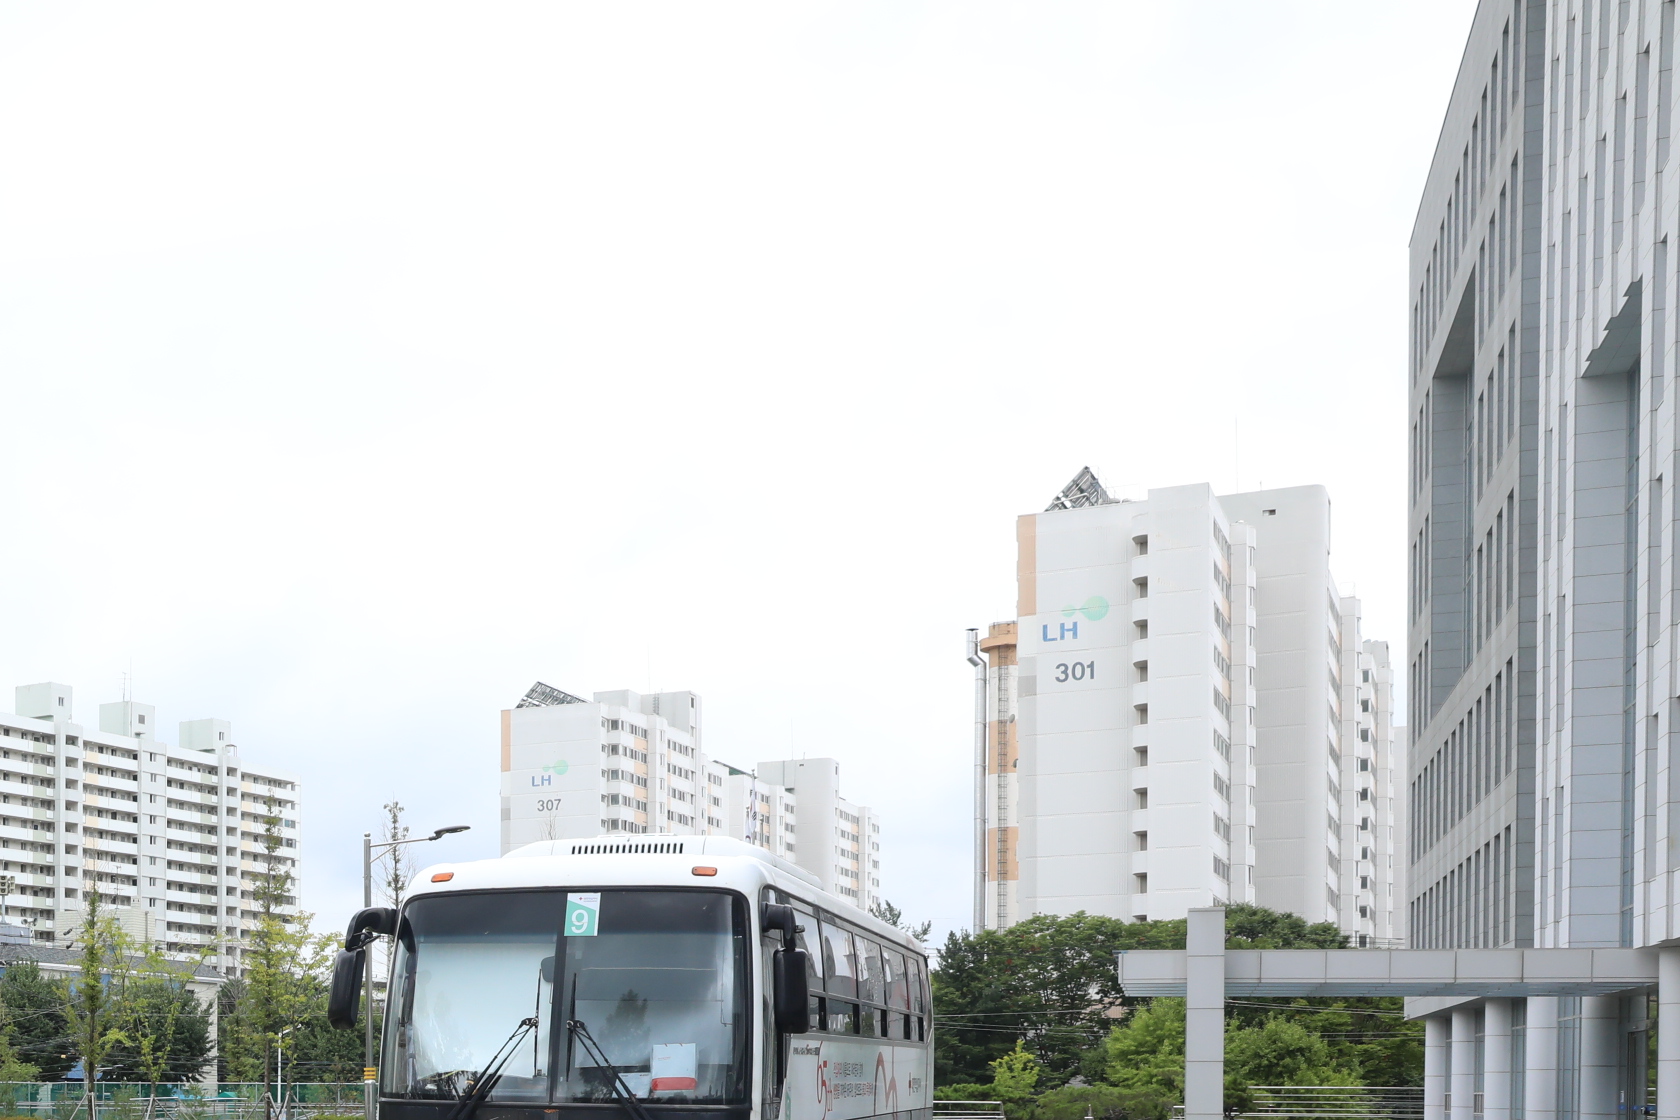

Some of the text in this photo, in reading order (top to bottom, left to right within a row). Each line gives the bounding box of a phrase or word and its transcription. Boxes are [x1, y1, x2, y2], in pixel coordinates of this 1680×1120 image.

[1042, 622, 1078, 642] LH
[1054, 661, 1096, 683] 301
[531, 775, 552, 787] LH
[536, 798, 562, 812] 307
[571, 909, 589, 934] 9
